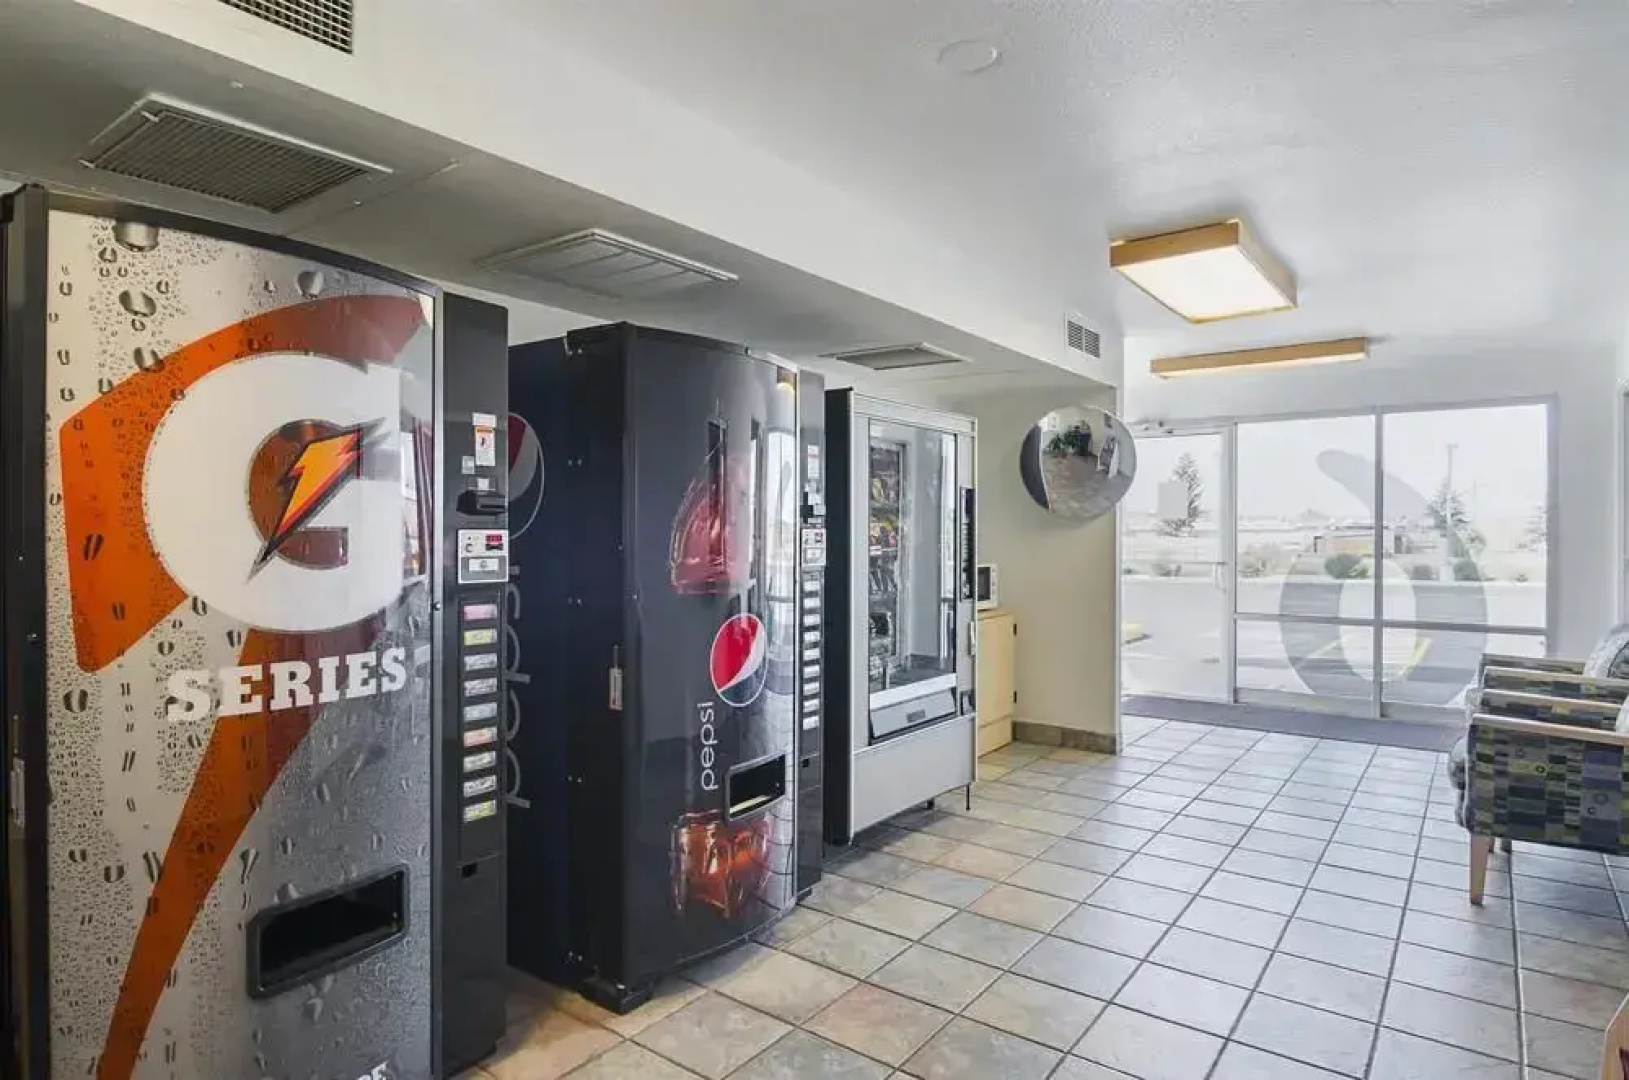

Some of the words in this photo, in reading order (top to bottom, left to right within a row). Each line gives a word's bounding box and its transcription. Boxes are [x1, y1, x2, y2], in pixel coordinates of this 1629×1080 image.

[142, 351, 403, 632] G
[167, 646, 407, 721] SERIES
[697, 701, 719, 791] pepsi
